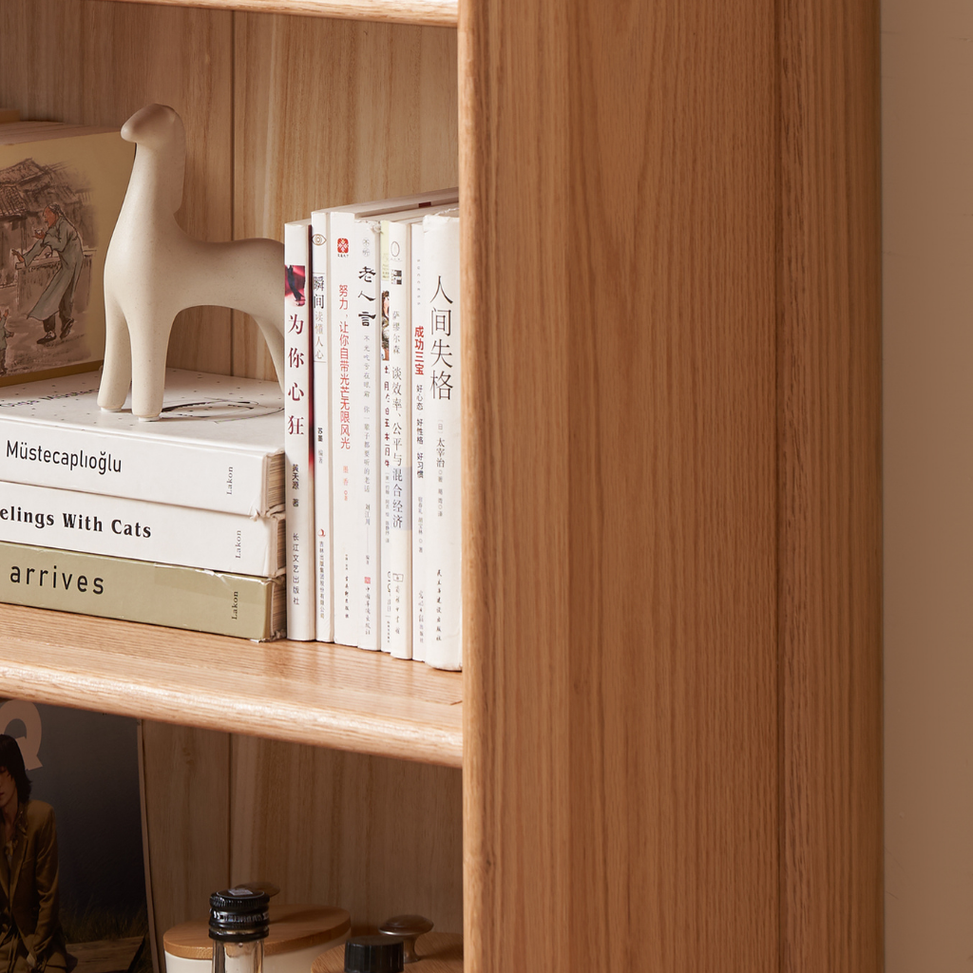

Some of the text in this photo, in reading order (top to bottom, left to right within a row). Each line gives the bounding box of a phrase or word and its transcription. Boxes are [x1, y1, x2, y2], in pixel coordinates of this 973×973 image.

[312, 275, 325, 361] 瞬间读懂人心
[357, 265, 377, 327] 老人言
[392, 310, 401, 355] 萨缪尔森
[414, 325, 425, 376] 成功三宝
[429, 274, 454, 401] 人间失格
[287, 313, 305, 436] 为你心狂
[338, 284, 351, 450] 努力，让你自带光芒无限风光
[6, 439, 123, 475] Müstecaplıoğlu
[391, 366, 404, 529] 谈效率、公平与混合经济
[436, 437, 445, 468] 太宰治
[226, 465, 234, 496] Lakon
[62, 513, 104, 533] With
[111, 518, 152, 538] Cats
[10, 563, 105, 595] arrives
[292, 532, 300, 606] 长江文艺出版社
[231, 590, 239, 620] Lakon
